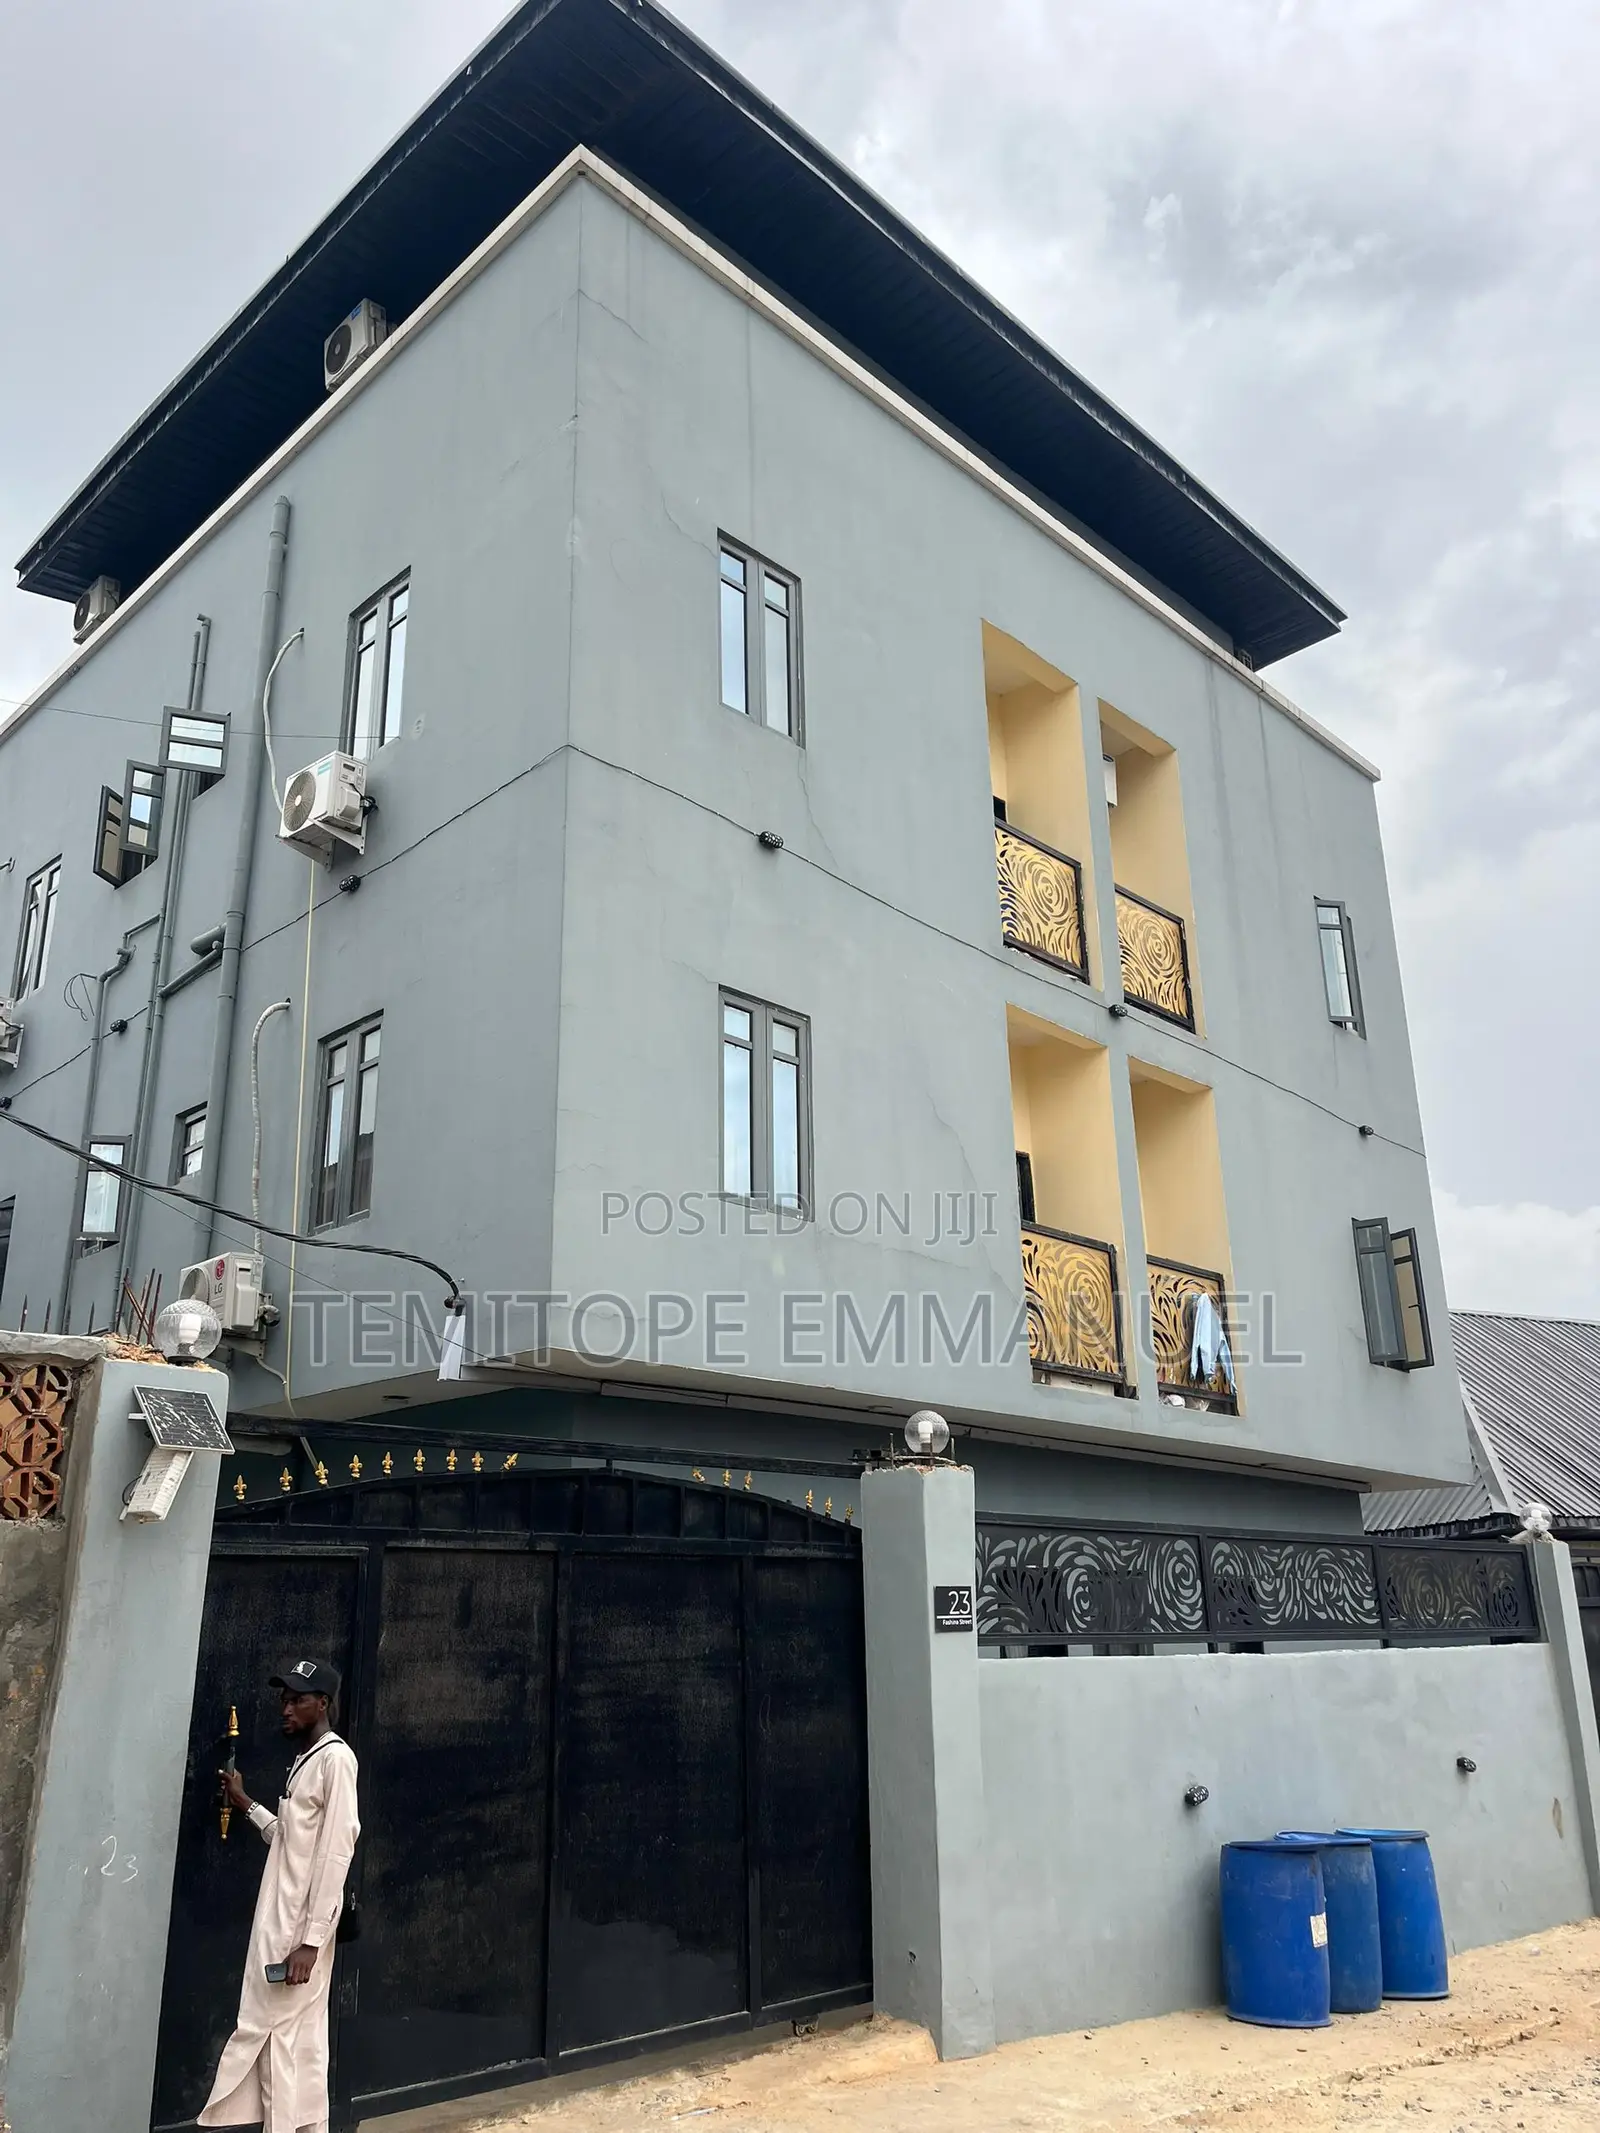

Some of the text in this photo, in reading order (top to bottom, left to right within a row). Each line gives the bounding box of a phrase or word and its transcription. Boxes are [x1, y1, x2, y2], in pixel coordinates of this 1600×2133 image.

[214, 1283, 223, 1295] LG
[948, 1590, 971, 1615] 23
[100, 1834, 139, 1884] 23
